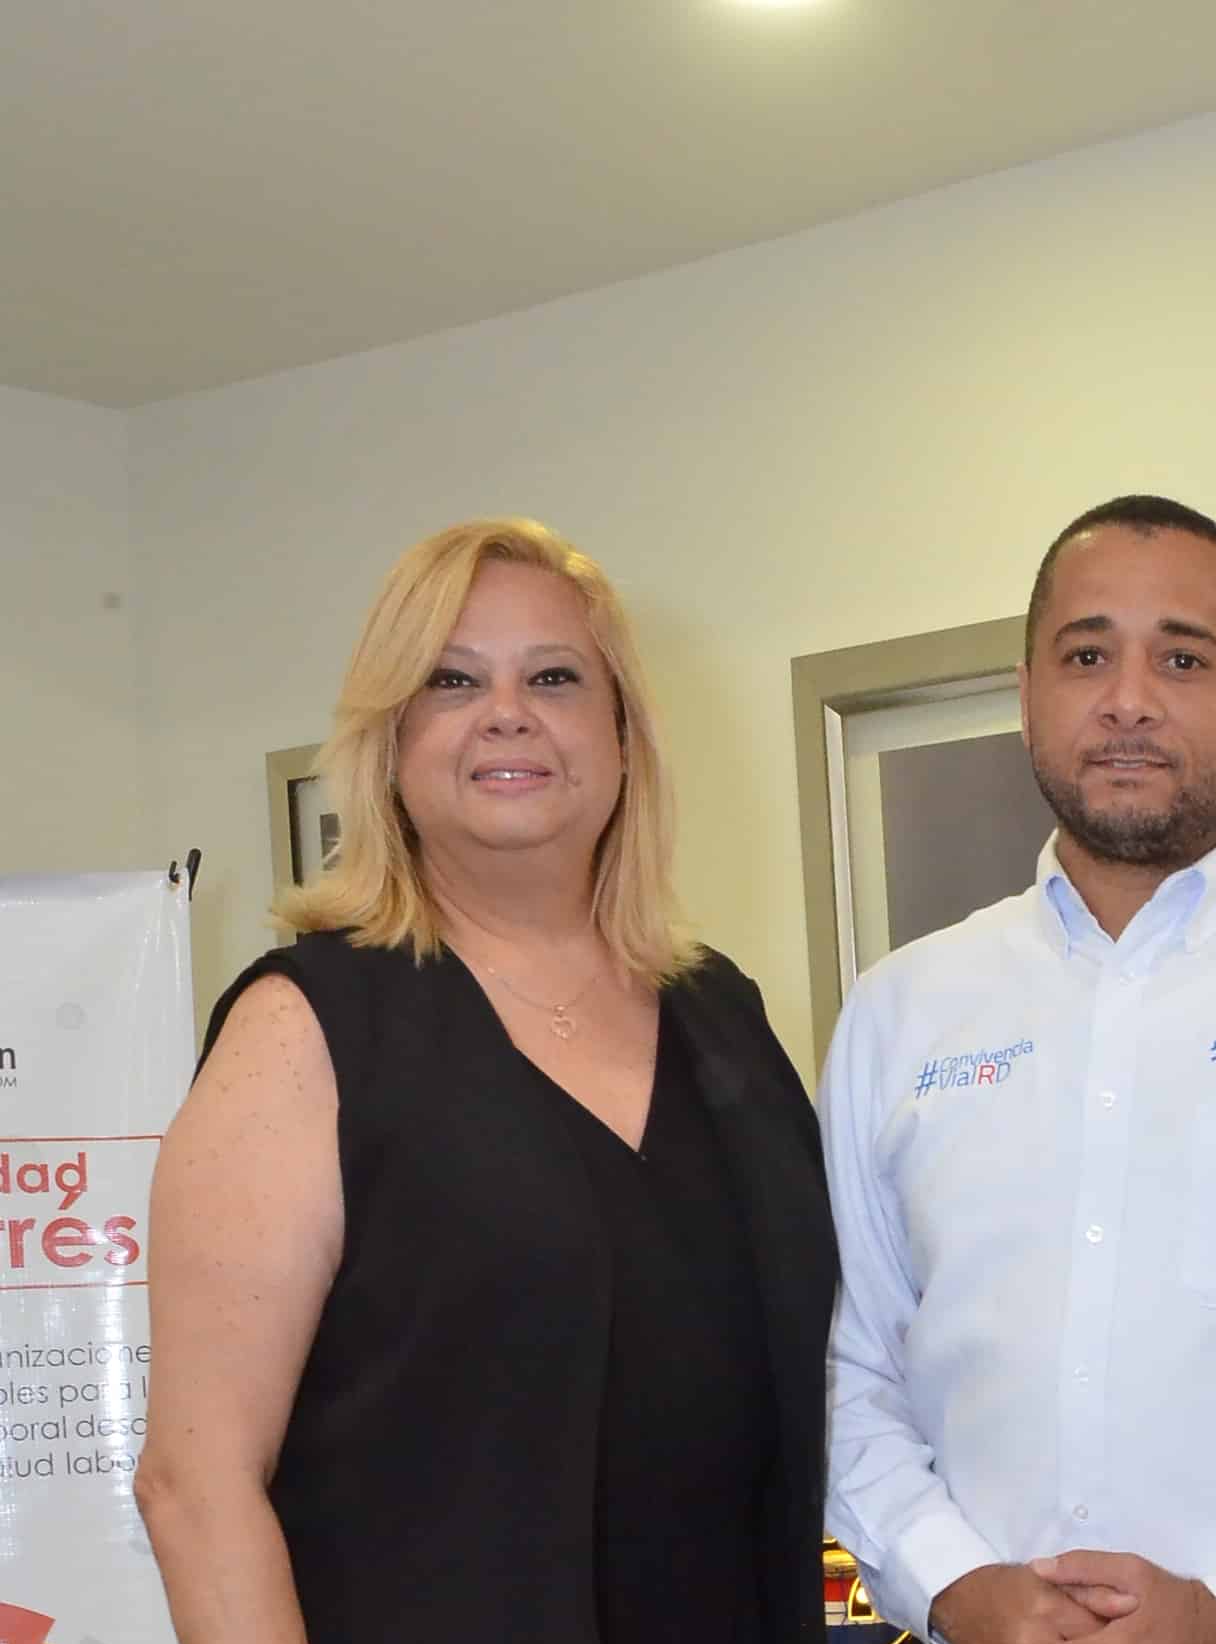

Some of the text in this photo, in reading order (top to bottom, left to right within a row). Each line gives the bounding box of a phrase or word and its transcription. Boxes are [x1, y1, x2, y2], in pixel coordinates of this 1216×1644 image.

[0, 1191, 141, 1268] rés
[0, 1341, 152, 1368] nizacione
[60, 1383, 132, 1409] paa
